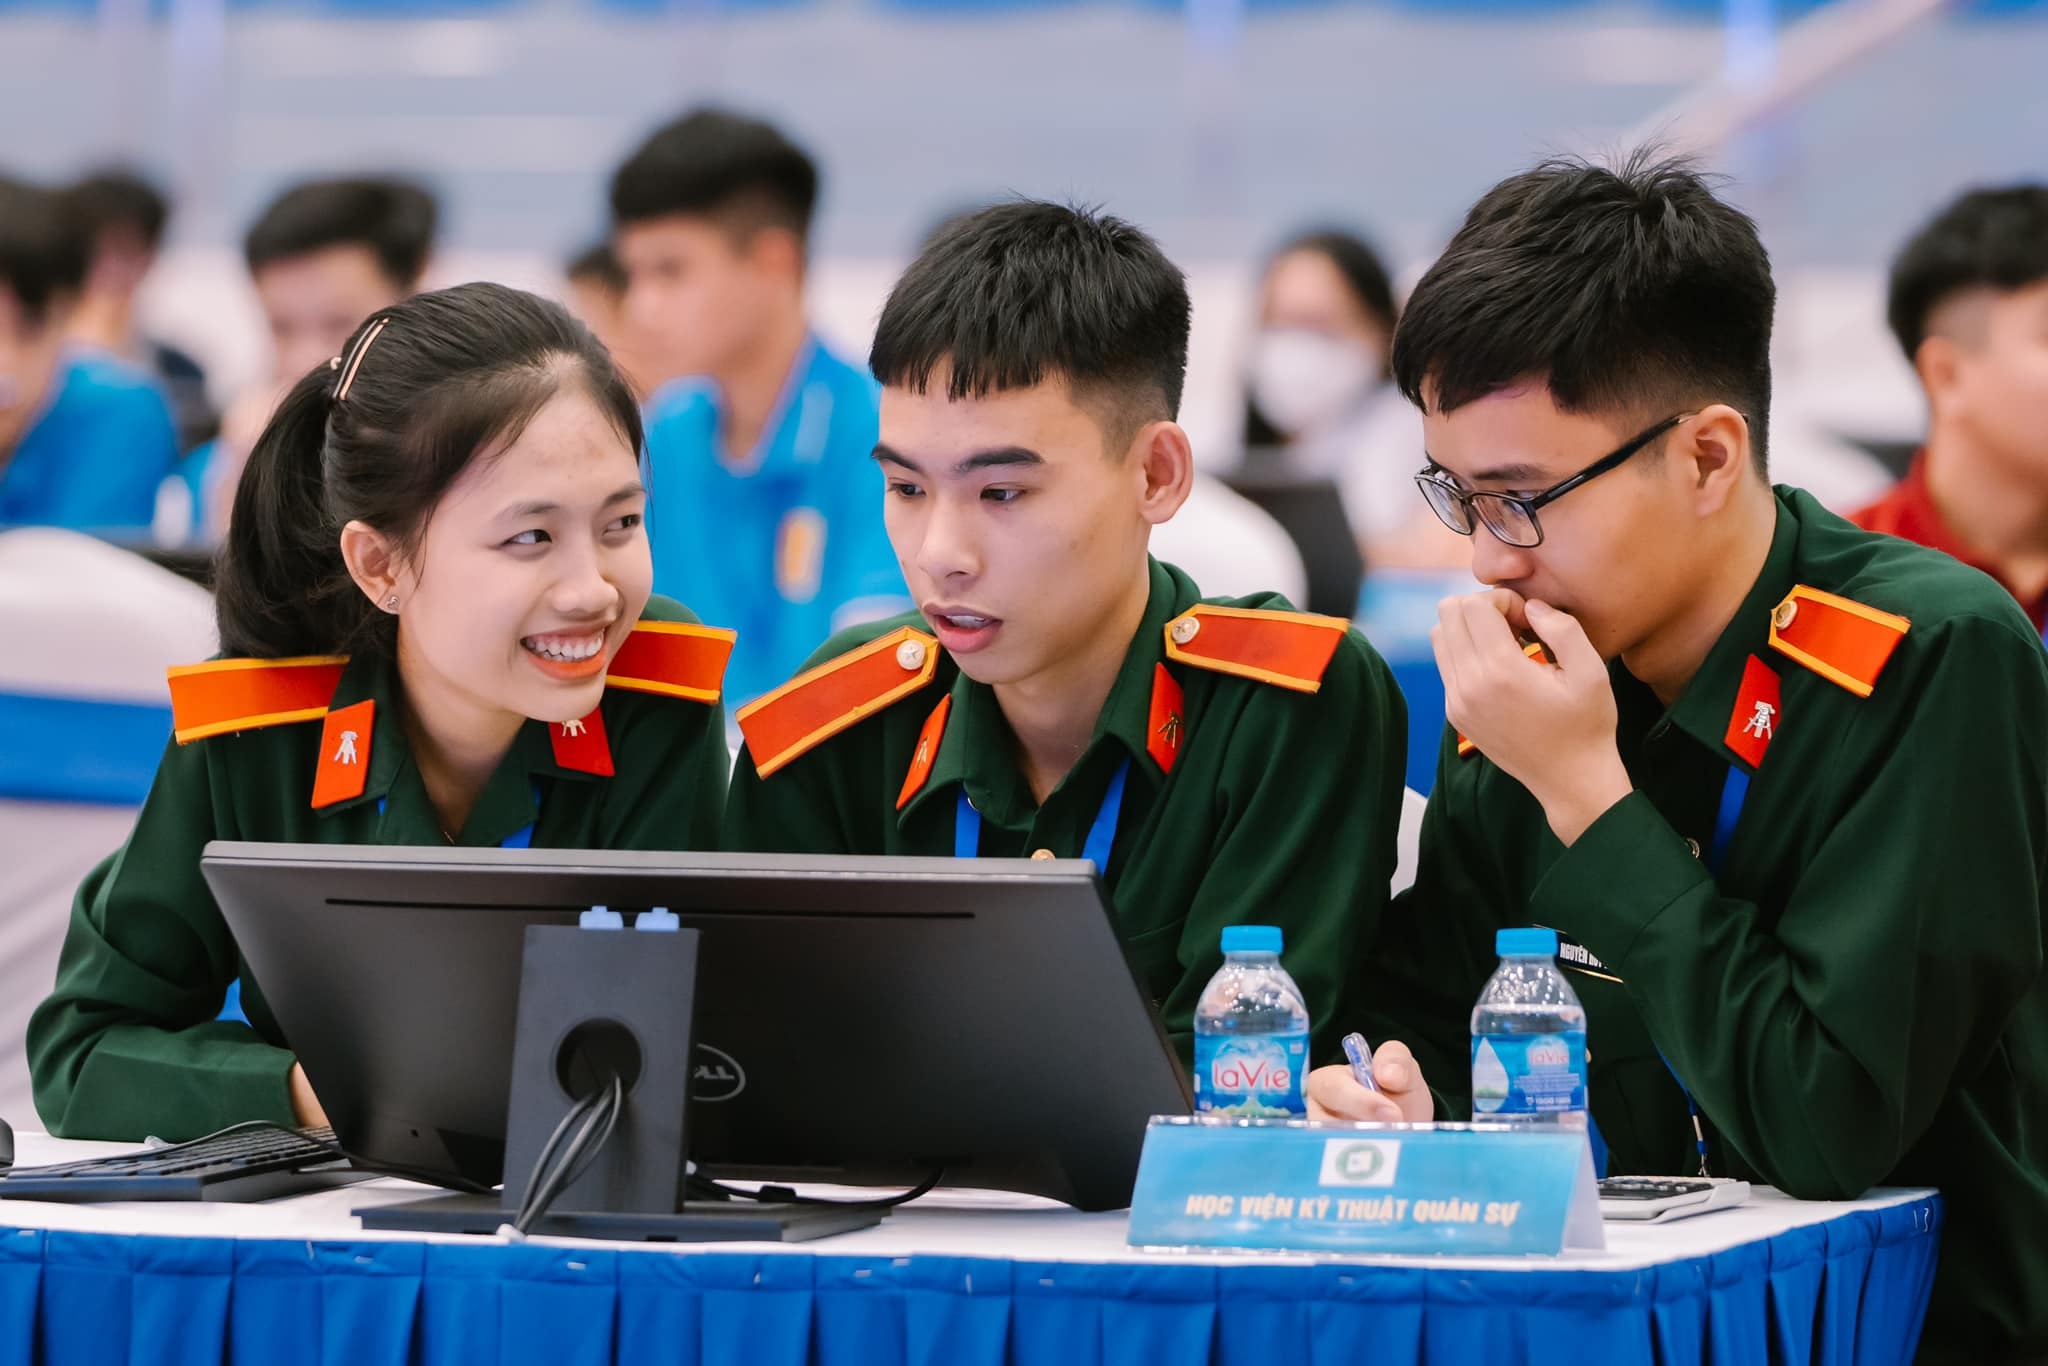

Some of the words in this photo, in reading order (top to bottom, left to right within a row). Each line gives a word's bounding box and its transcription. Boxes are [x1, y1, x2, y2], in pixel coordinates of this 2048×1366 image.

[1214, 1059, 1289, 1088] laVie
[1185, 1194, 1234, 1220] HỌC
[1241, 1192, 1294, 1221] VIỆN
[1299, 1194, 1331, 1220] KỸ
[1337, 1194, 1409, 1225] THUẬT
[1413, 1197, 1480, 1224] QUÂN
[1484, 1201, 1521, 1228] SỰ
